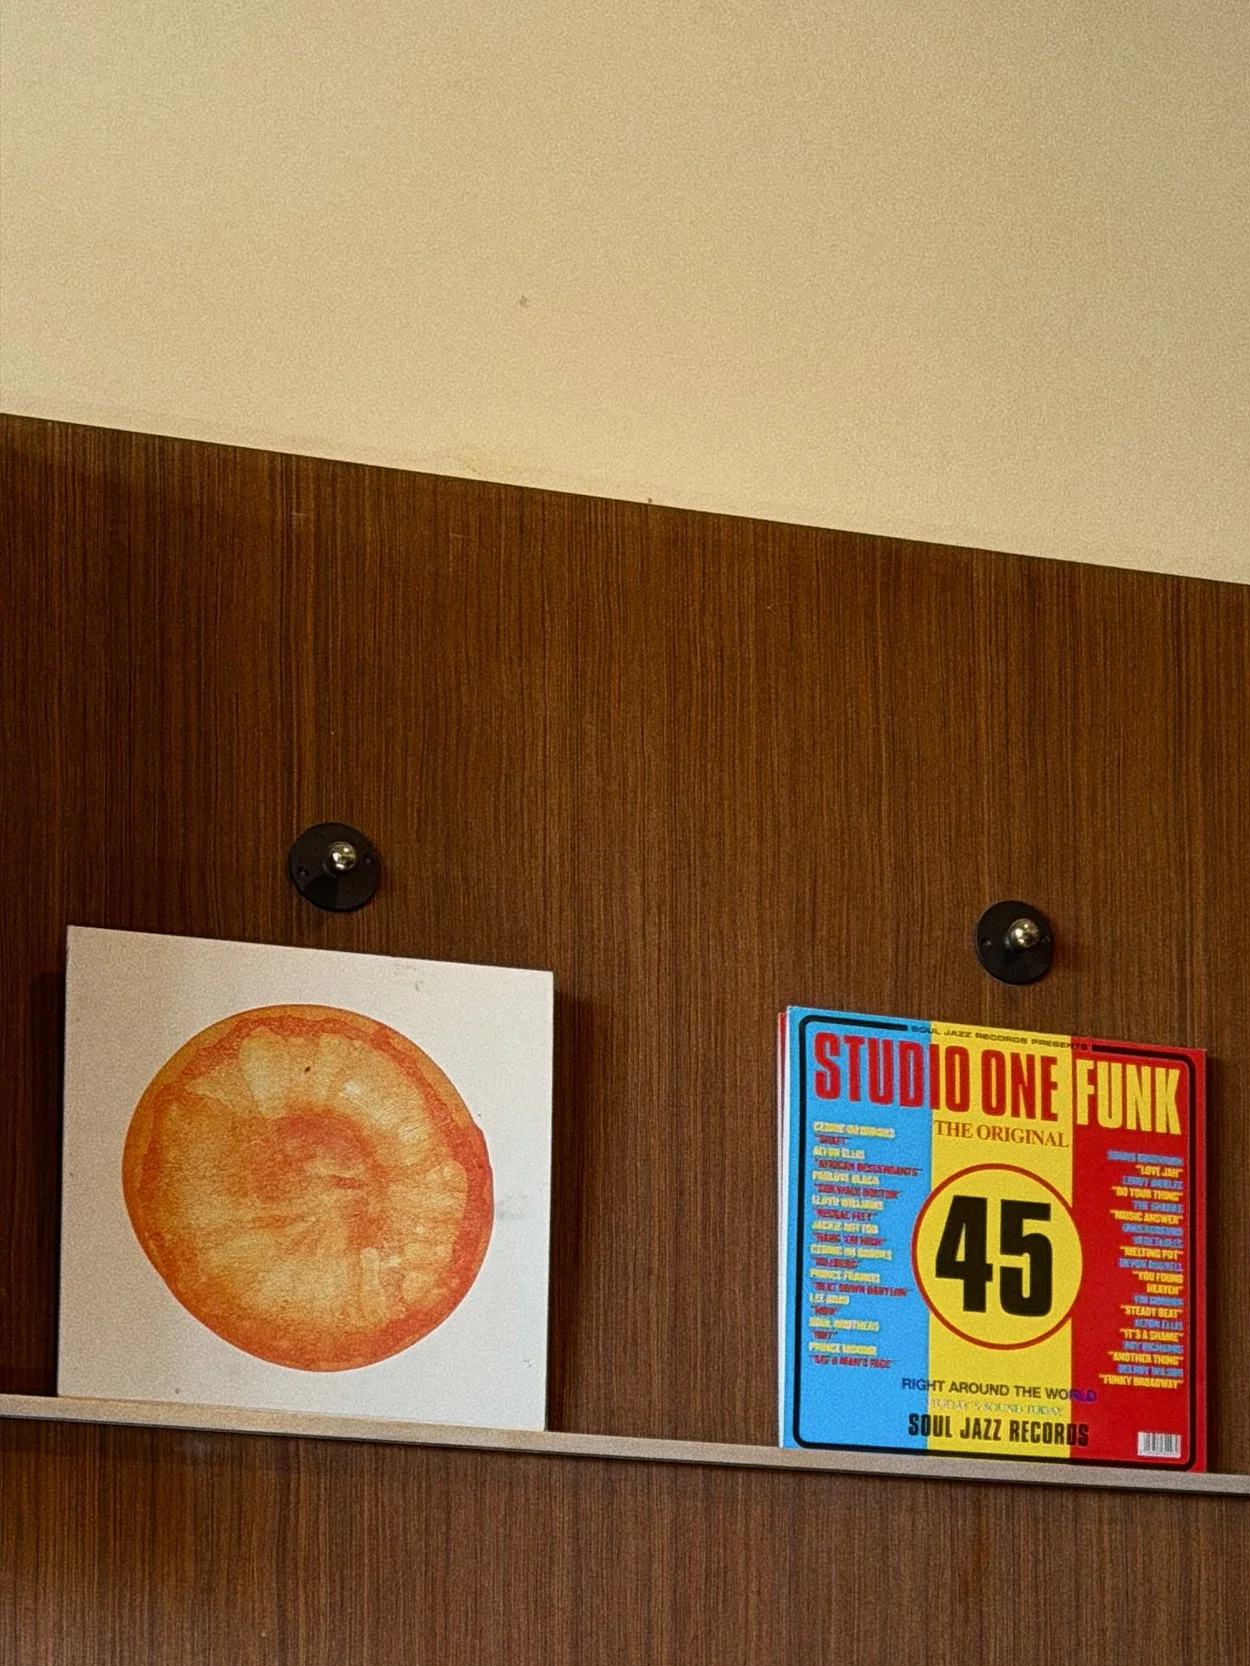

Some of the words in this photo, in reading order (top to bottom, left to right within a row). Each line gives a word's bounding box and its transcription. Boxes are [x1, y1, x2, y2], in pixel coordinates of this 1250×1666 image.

[911, 1025, 939, 1035] SOUL
[944, 1029, 972, 1038] JAZZ
[975, 1033, 1028, 1045] RECORDS
[1031, 1038, 1088, 1051] PRESENTS
[813, 1031, 970, 1113] STUDIO
[981, 1049, 1058, 1122] ONE
[1075, 1058, 1182, 1135] FUNK
[934, 1120, 973, 1139] THE
[976, 1124, 1070, 1148] ORIGINAL
[935, 1193, 1053, 1318] 45
[901, 1377, 945, 1393] RIGHT
[949, 1381, 1010, 1396] AROUND
[1014, 1385, 1041, 1398] THE
[1045, 1388, 1097, 1402] WORLD
[908, 1413, 953, 1439] SOUL
[959, 1417, 1002, 1441] JAZZ
[1009, 1420, 1089, 1446] RECORDS
